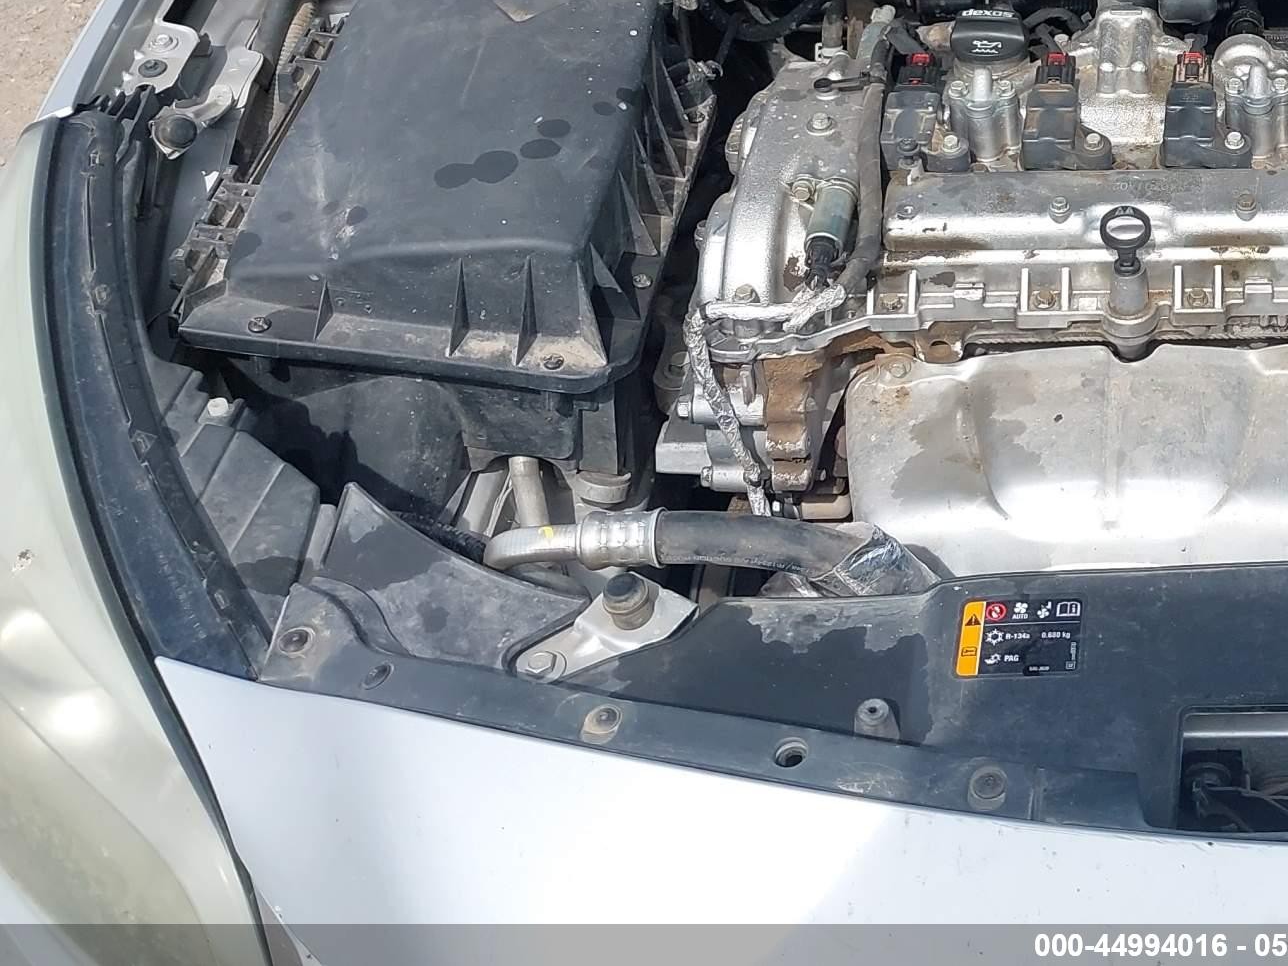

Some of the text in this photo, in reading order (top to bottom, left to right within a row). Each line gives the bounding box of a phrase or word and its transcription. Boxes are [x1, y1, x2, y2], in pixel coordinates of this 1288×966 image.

[962, 9, 1014, 18] dexos
[1062, 631, 1071, 640] kg
[1004, 654, 1020, 663] PAG
